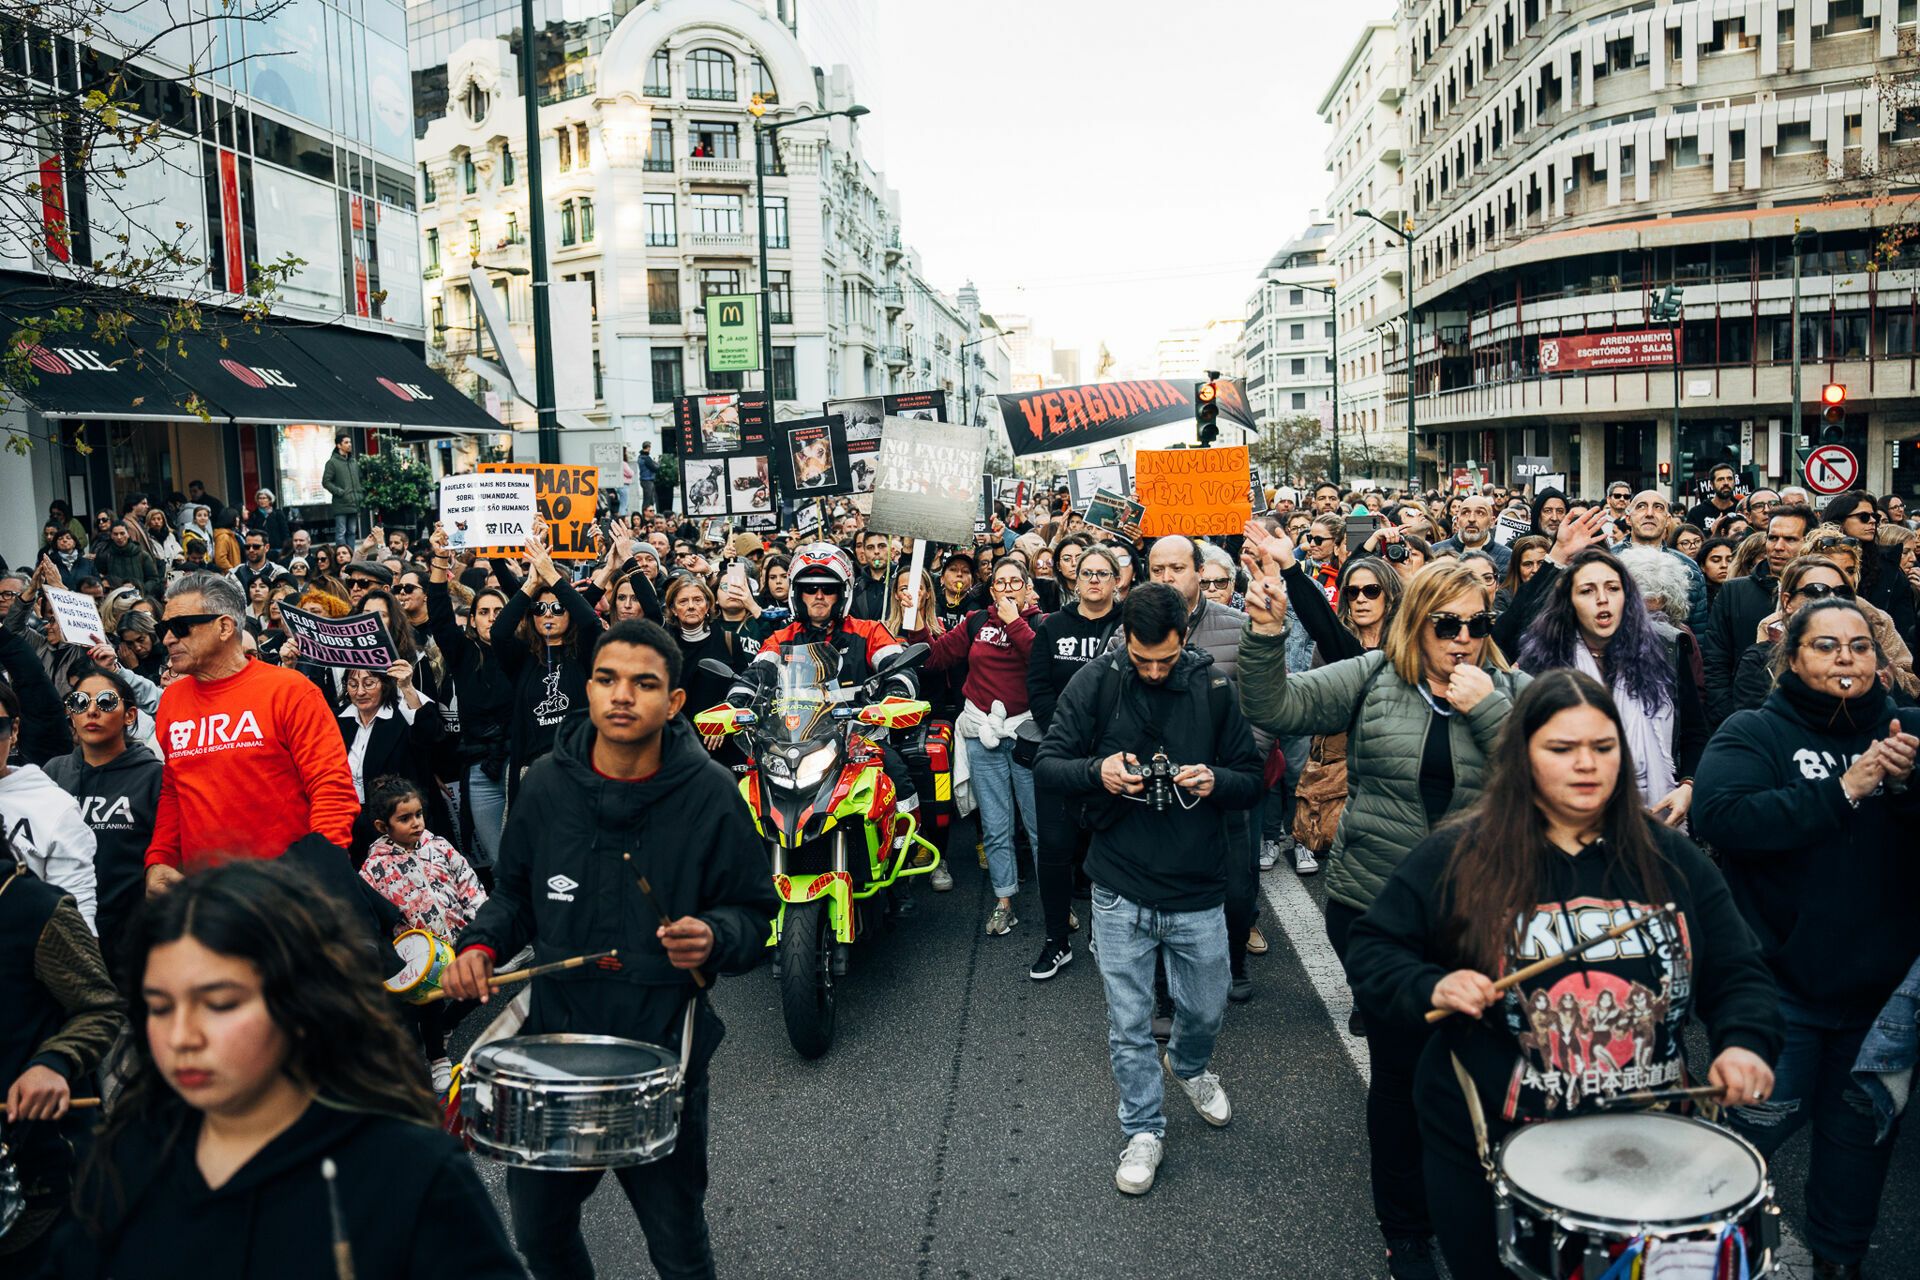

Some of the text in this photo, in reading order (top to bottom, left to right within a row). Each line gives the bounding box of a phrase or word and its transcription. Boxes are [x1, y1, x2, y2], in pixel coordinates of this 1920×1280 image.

[1578, 345, 1631, 357] ESCRITÓRIOS
[1642, 343, 1673, 353] SALAS
[1600, 333, 1672, 346] ARRENDAMENTO
[1019, 379, 1189, 441] VERGONHA
[885, 438, 982, 466] NO EXCUSE
[1136, 449, 1245, 474] ANIMAIS
[882, 453, 976, 479] FOR ANIMAL
[1527, 464, 1548, 474] IRA
[1137, 475, 1194, 506] TÊM
[1201, 480, 1251, 505] VOZ
[487, 503, 500, 512] SÃO
[501, 504, 530, 512] HUMANOS
[500, 522, 524, 535] IRA
[1141, 512, 1243, 536] A NOSSA
[51, 593, 79, 607] PRISÃO
[58, 606, 98, 622] MAUS TRATOS
[72, 620, 98, 632] ANIMAIS
[283, 609, 377, 636] PELOS DIREITOS
[295, 623, 378, 647] DE TODOS OS
[299, 636, 388, 665] ANIMAIS
[197, 710, 264, 747] IRA
[208, 743, 235, 753] RESGATE
[235, 740, 264, 749] ANIMAL
[74, 796, 135, 823] RA
[1516, 908, 1655, 962] KISS
